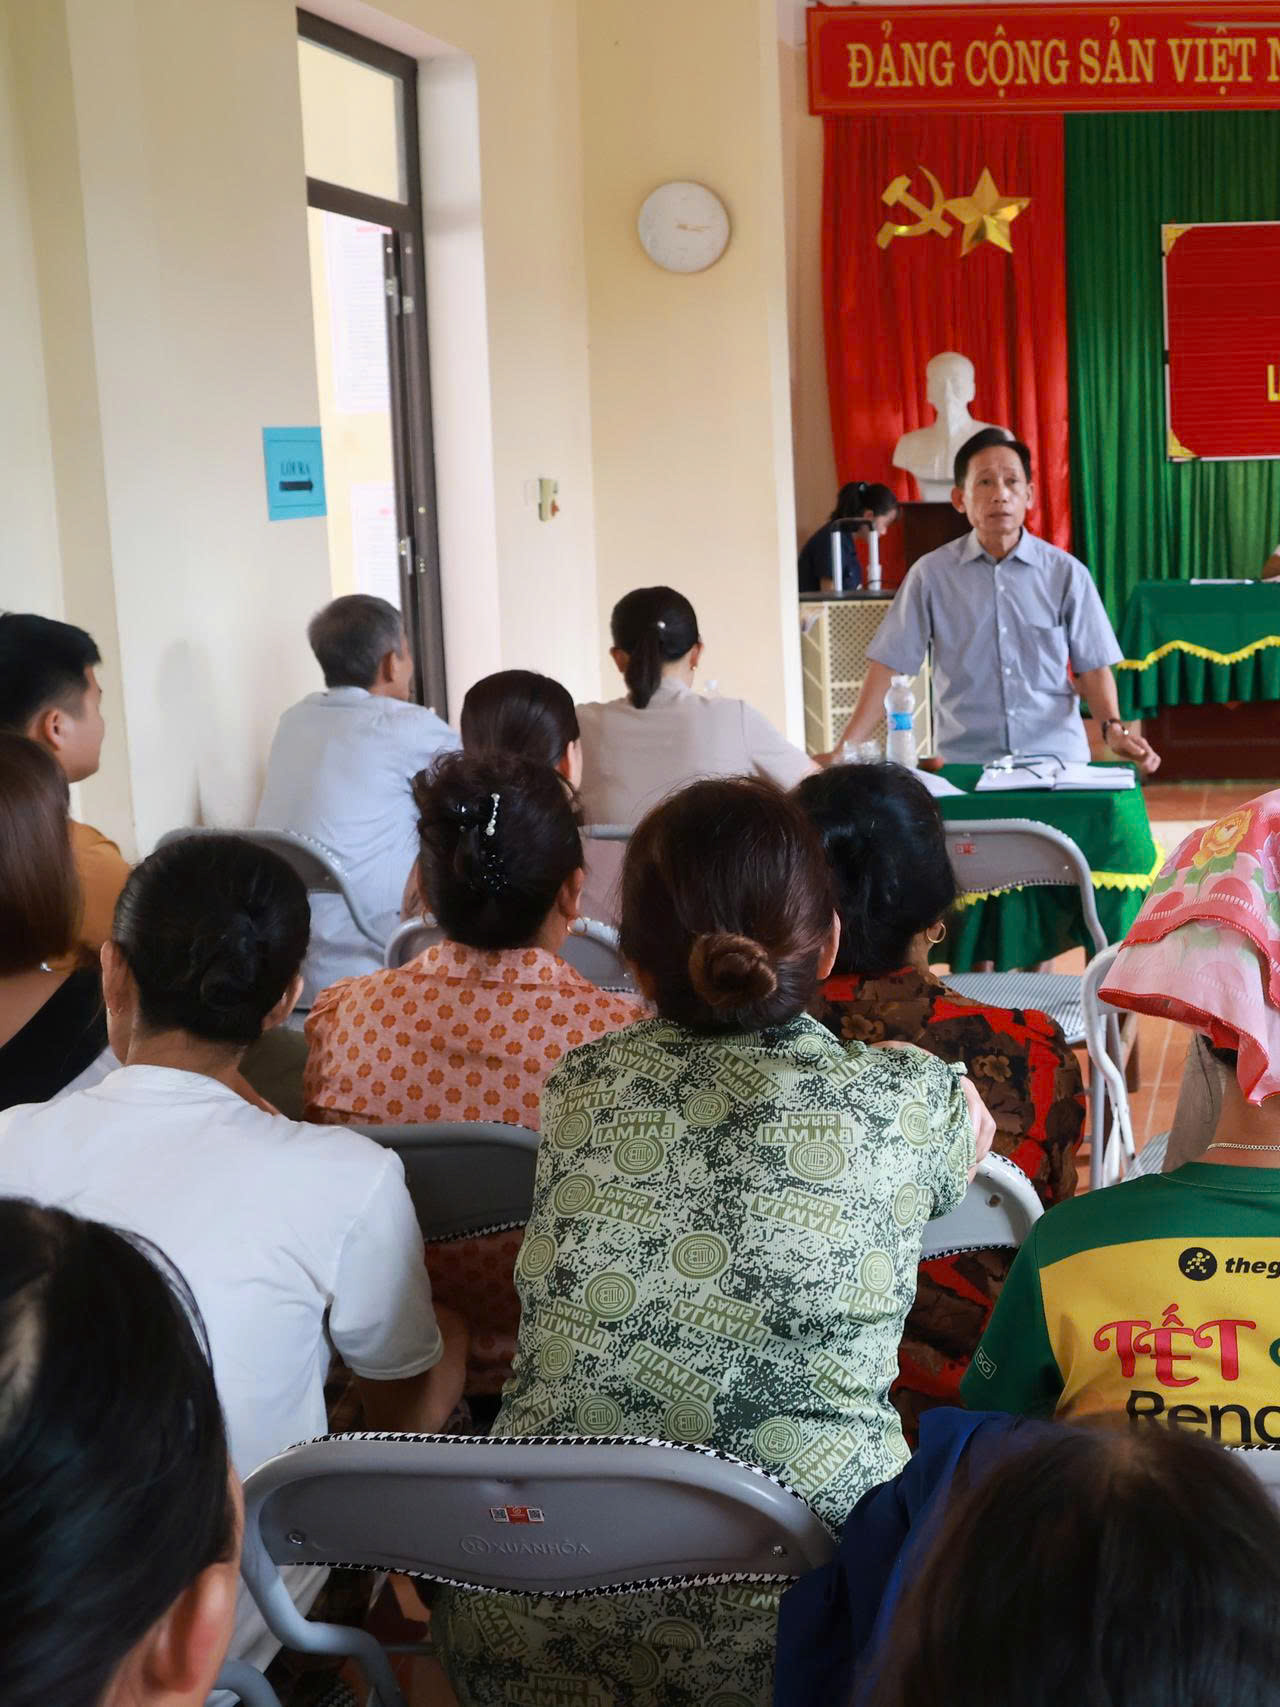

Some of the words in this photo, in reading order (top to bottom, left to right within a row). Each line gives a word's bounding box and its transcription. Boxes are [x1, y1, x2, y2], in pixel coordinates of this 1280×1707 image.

[847, 20, 955, 88] ĐẢNG
[965, 24, 1071, 98] CỘNG
[1079, 16, 1156, 84] SẢN
[1168, 26, 1257, 95] VIỆT
[713, 1050, 777, 1097] ALMAIN
[718, 1071, 752, 1097] PARIS
[1094, 1303, 1257, 1387] TẾT
